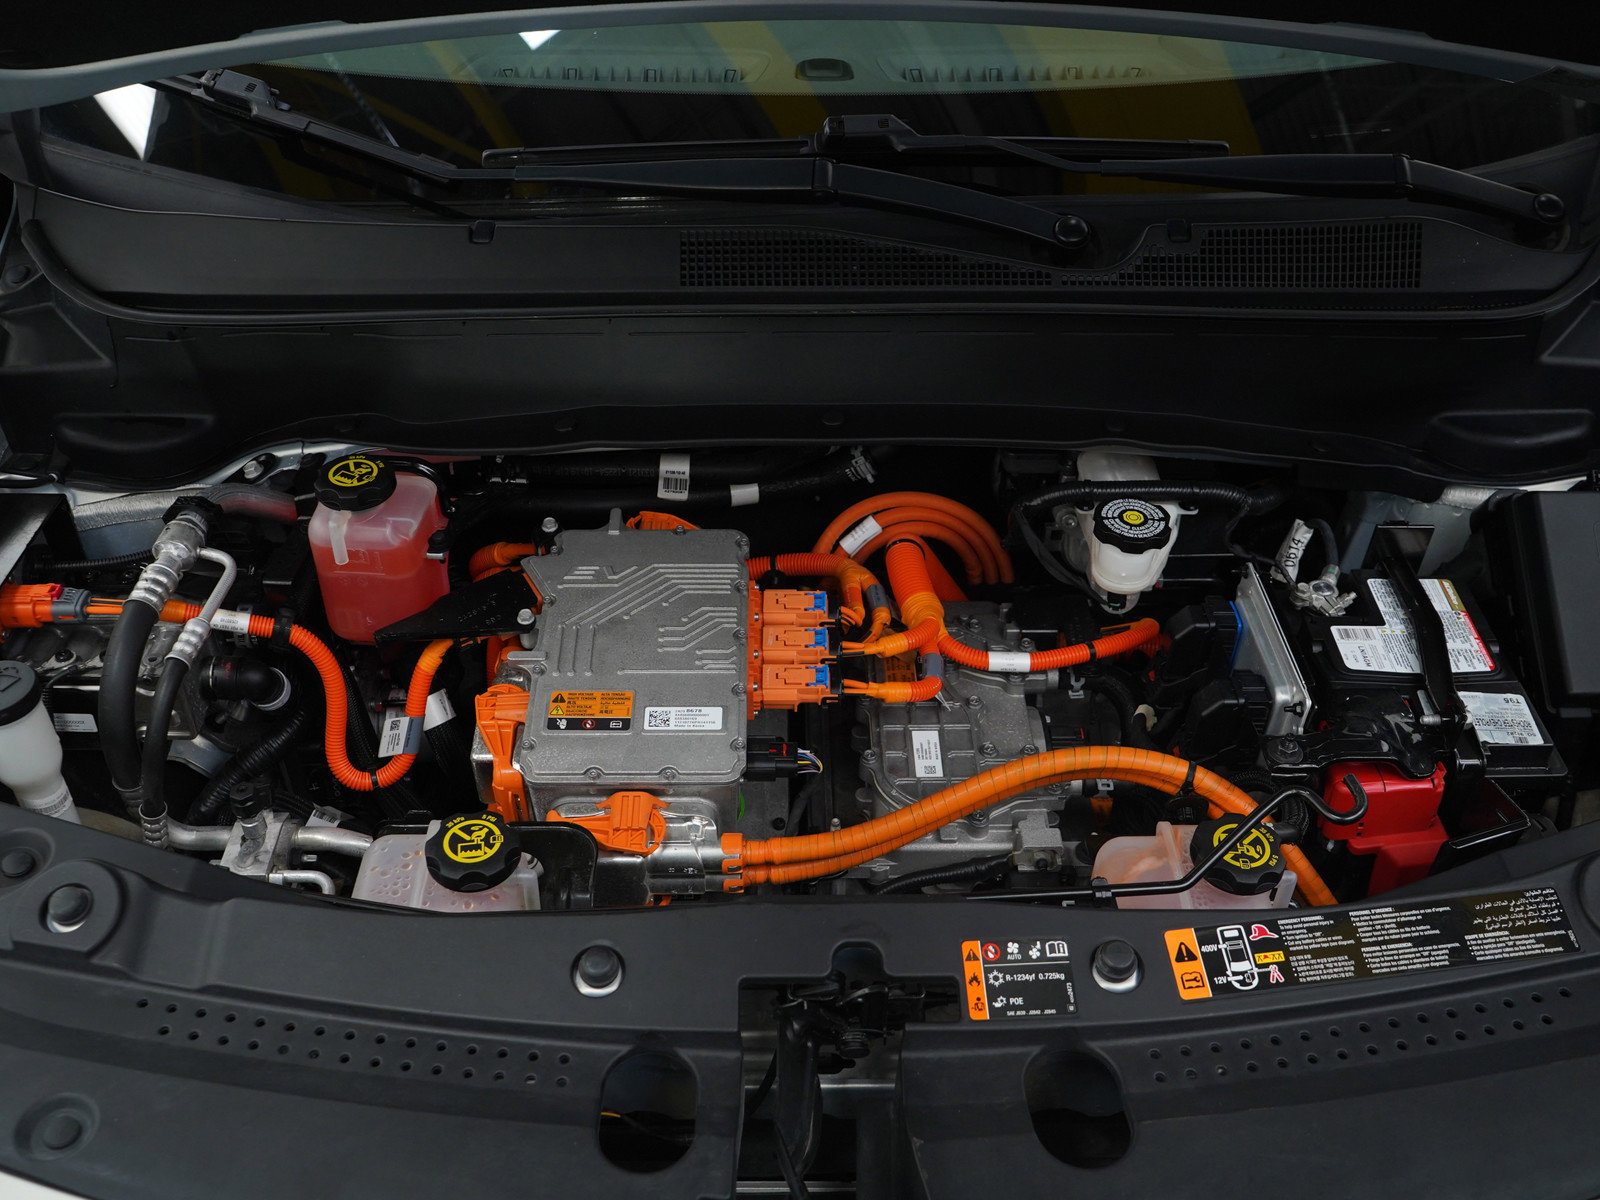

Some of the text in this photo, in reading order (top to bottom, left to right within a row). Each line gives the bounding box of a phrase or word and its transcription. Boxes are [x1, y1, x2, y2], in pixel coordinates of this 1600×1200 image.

[1201, 944, 1217, 952] 400V
[1006, 972, 1065, 981] R-1234yf 0.725kg
